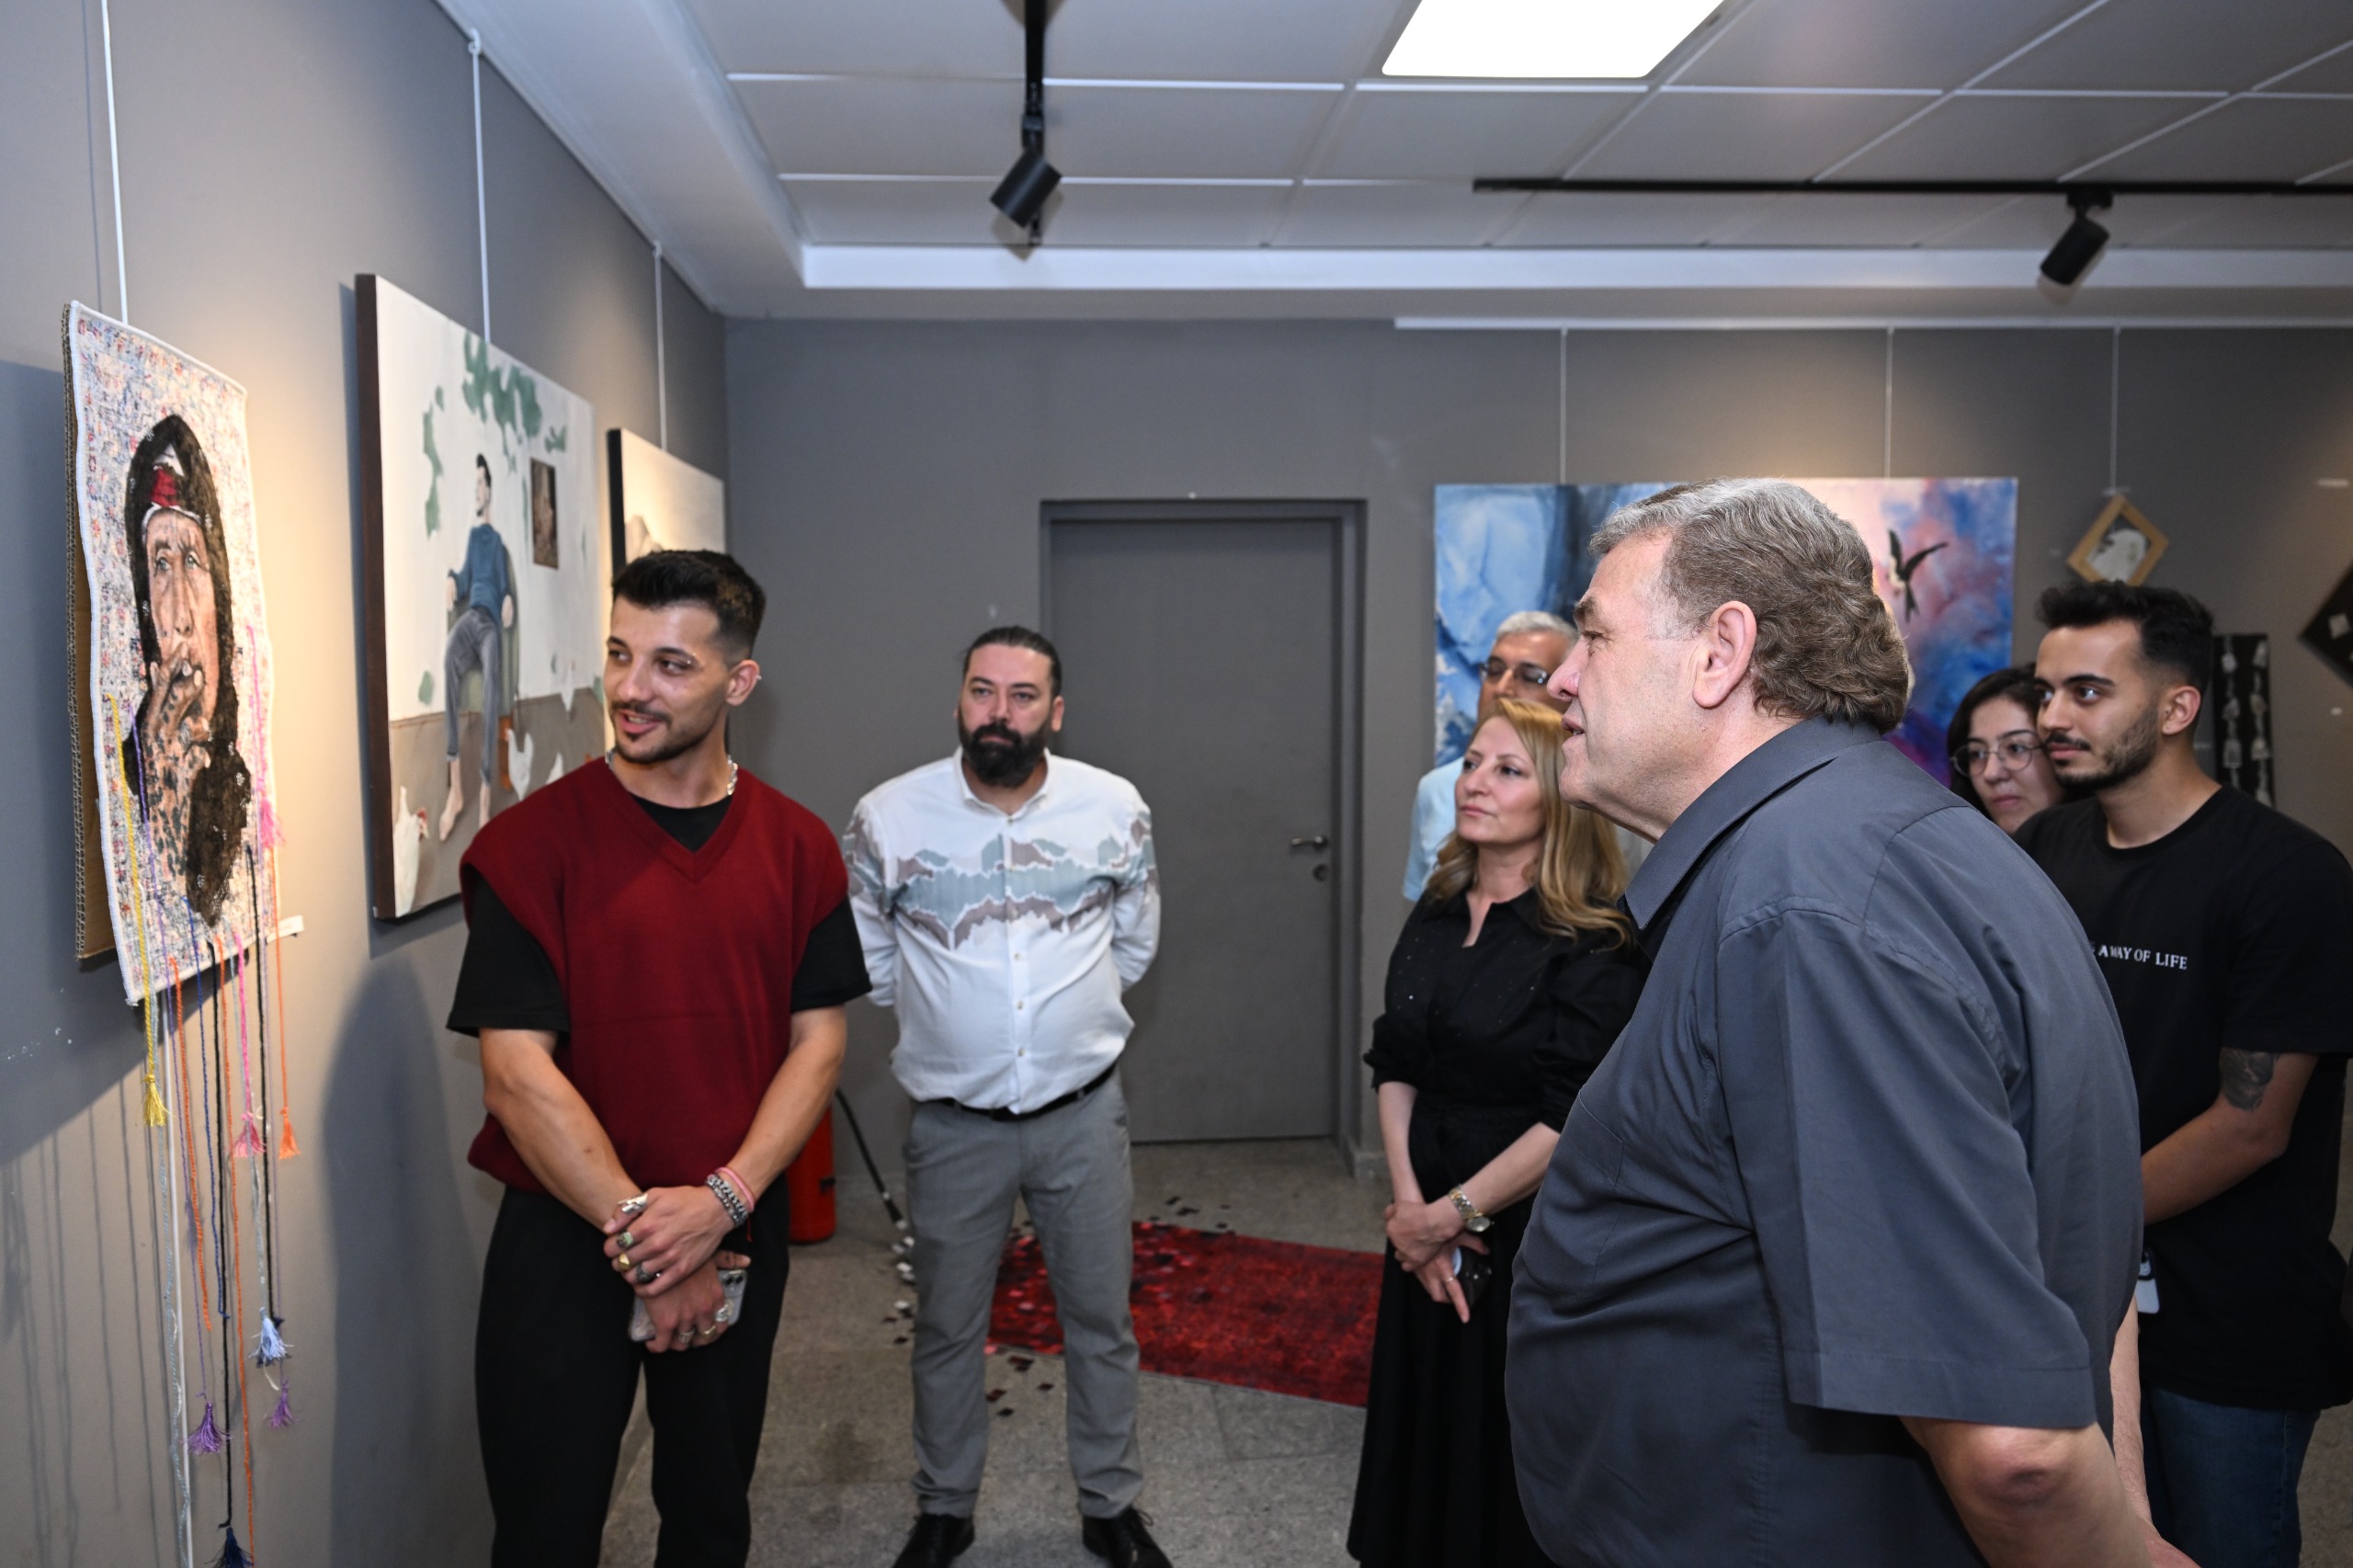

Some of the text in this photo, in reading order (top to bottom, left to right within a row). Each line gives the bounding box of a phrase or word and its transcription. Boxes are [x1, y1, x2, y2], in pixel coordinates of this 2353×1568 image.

[2097, 944, 2109, 958] A
[2133, 949, 2152, 963] OF
[2155, 952, 2188, 970] LIFE
